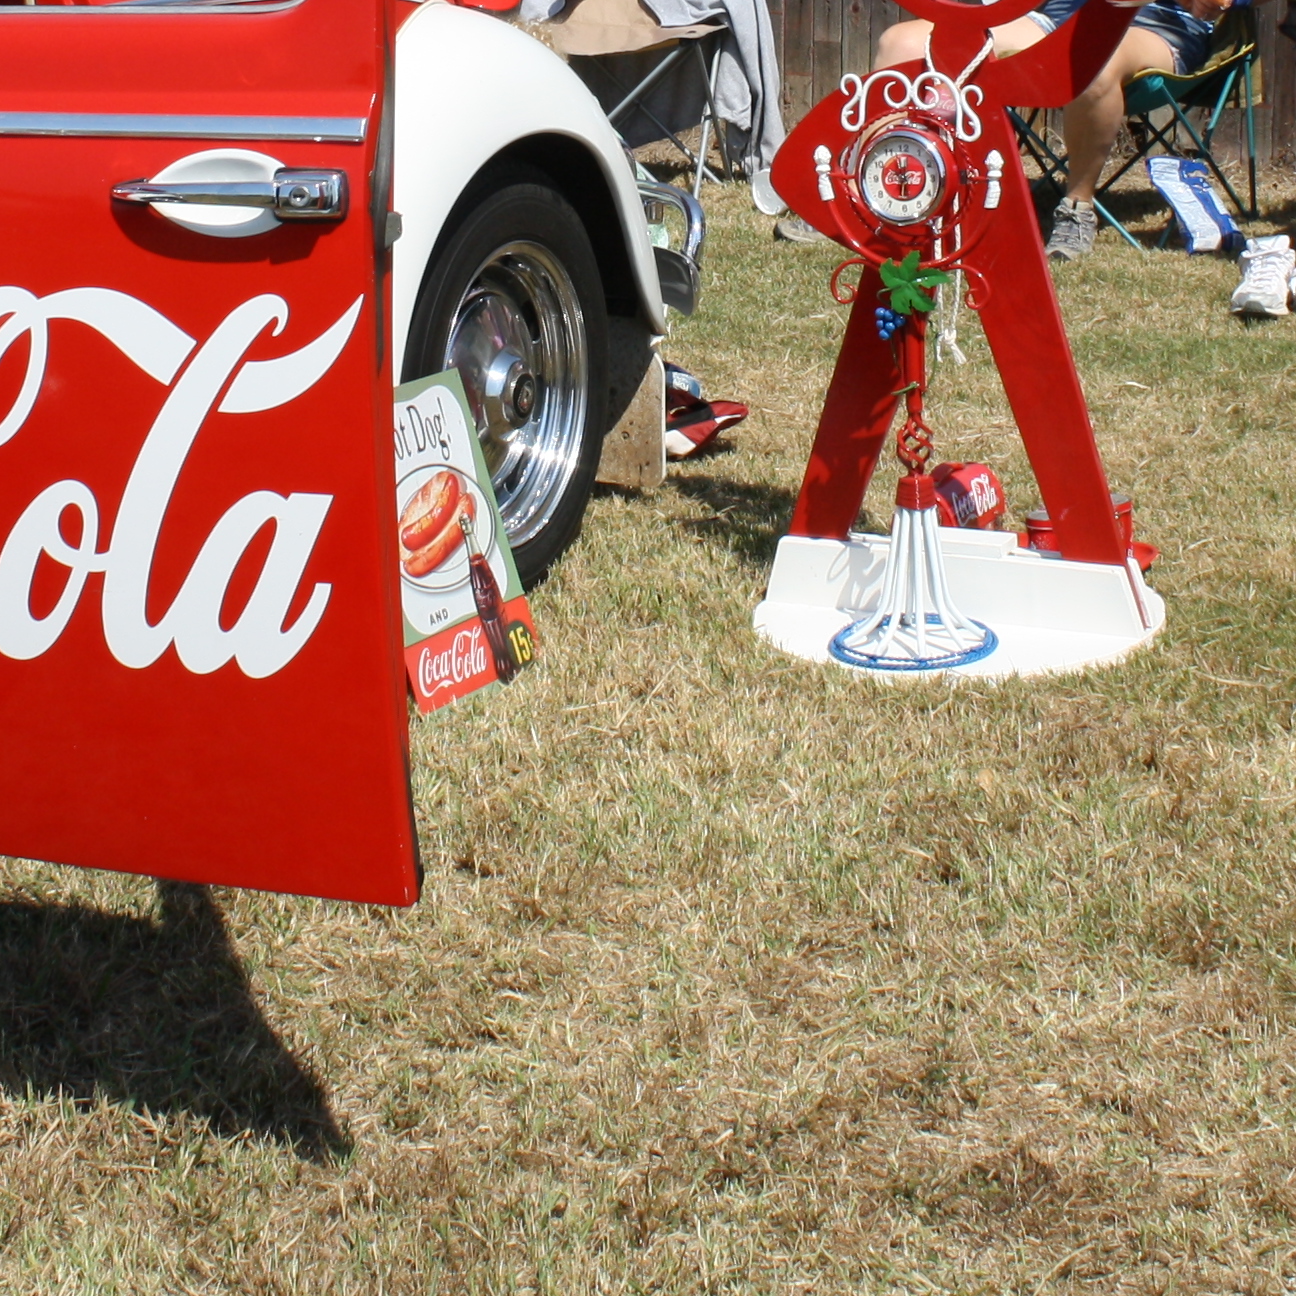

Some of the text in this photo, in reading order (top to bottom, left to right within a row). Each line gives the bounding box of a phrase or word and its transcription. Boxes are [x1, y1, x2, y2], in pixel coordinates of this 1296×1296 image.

[394, 396, 452, 461] ot Dog!
[430, 607, 449, 626] AND
[418, 625, 487, 698] Coca-Cola
